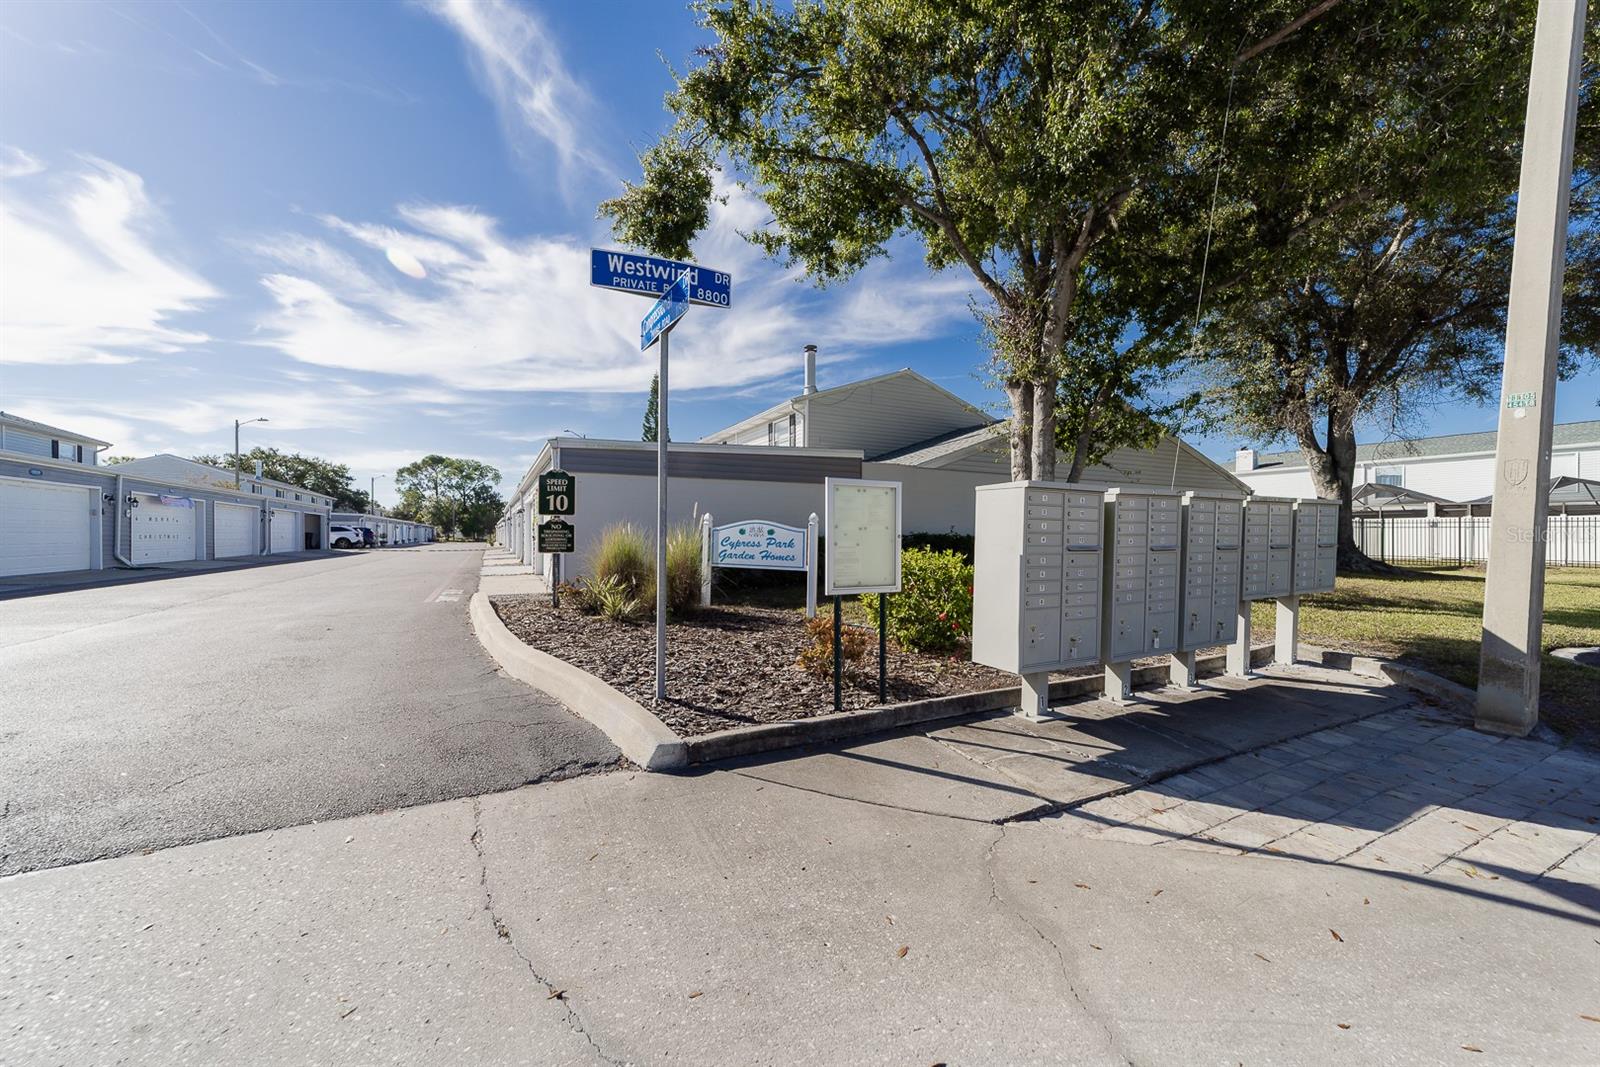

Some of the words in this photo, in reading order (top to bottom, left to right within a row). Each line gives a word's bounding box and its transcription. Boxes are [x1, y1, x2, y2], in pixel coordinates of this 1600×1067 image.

[714, 273, 730, 286] DR
[613, 277, 658, 291] PRIVATE
[697, 288, 728, 304] 8800
[546, 495, 568, 511] 10
[721, 536, 761, 549] Cypress
[766, 537, 795, 548] Park
[719, 550, 755, 562] Garden
[759, 550, 796, 561] Homes
